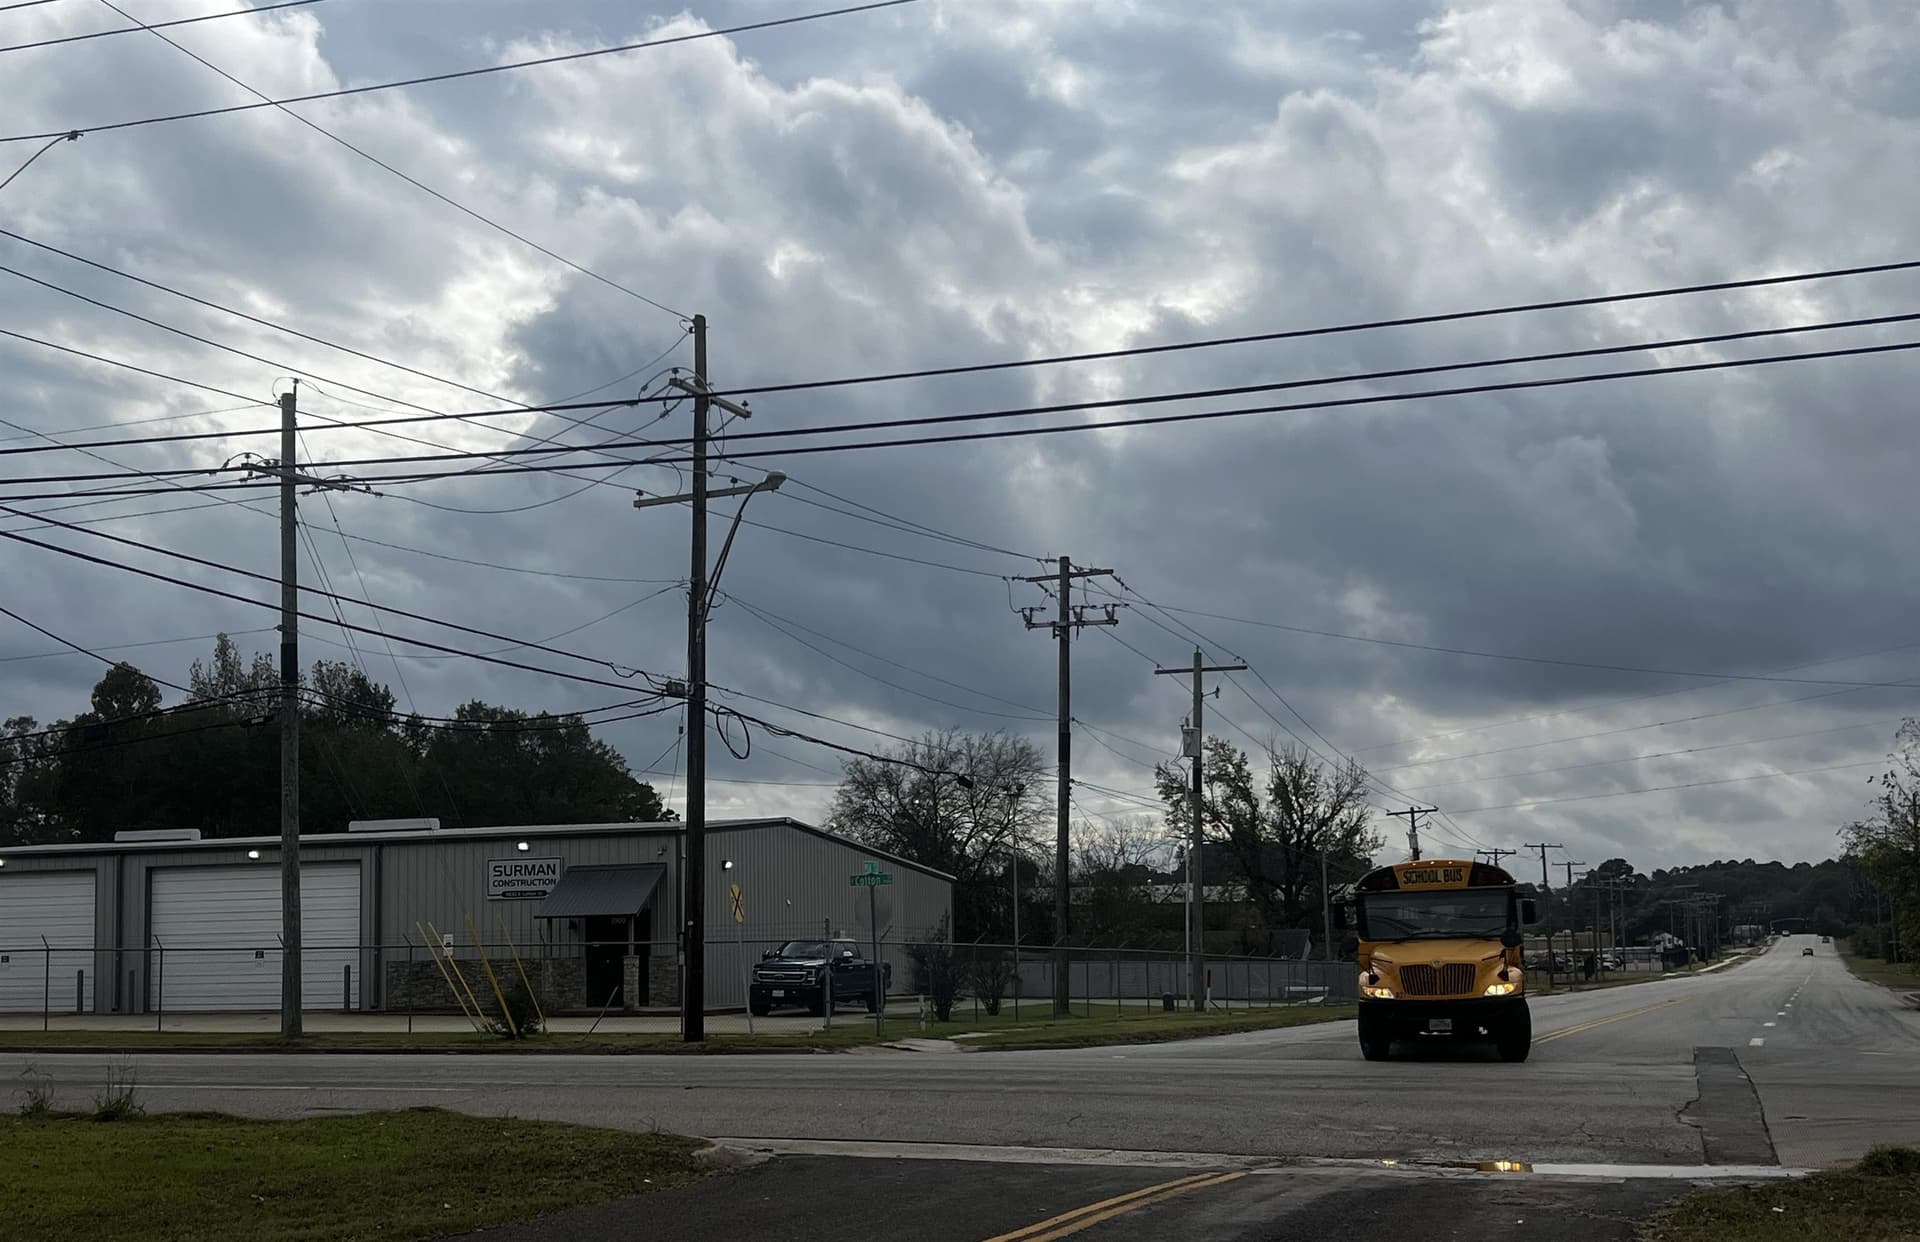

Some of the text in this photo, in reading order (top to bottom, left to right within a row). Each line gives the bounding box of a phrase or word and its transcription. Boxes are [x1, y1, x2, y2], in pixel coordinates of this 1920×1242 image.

[493, 864, 556, 877] SURMAN
[1403, 868, 1463, 884] SCHOOL BUS
[493, 878, 557, 887] CONSTRUCTION
